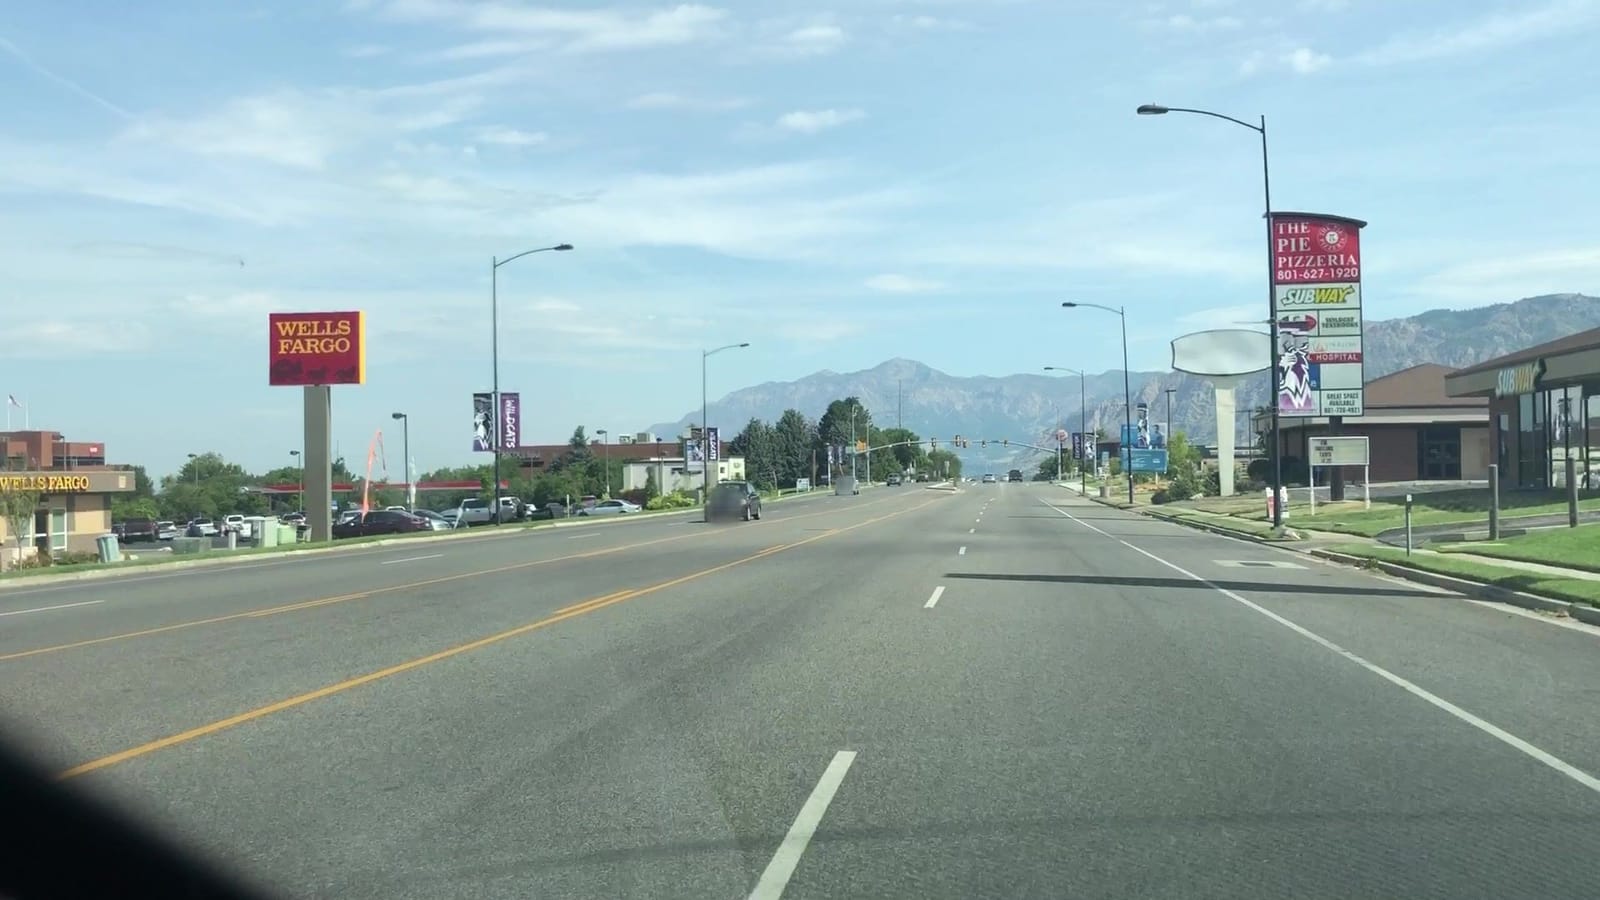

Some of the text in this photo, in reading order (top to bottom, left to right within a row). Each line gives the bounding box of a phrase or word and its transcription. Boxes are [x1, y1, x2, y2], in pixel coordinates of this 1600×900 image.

[1276, 222, 1311, 234] THE
[1277, 237, 1311, 252] PIE
[1277, 254, 1357, 269] PIZZERIA
[1277, 267, 1359, 280] 801-627-1920
[1281, 285, 1354, 306] SUBWAY
[276, 320, 351, 336] WELLS
[278, 338, 351, 354] FARGO
[1316, 353, 1358, 361] HOSPITAL
[1496, 359, 1540, 397] SUBWAY
[505, 399, 516, 449] WILDCATS
[0, 476, 89, 490] WELLS FARGO
